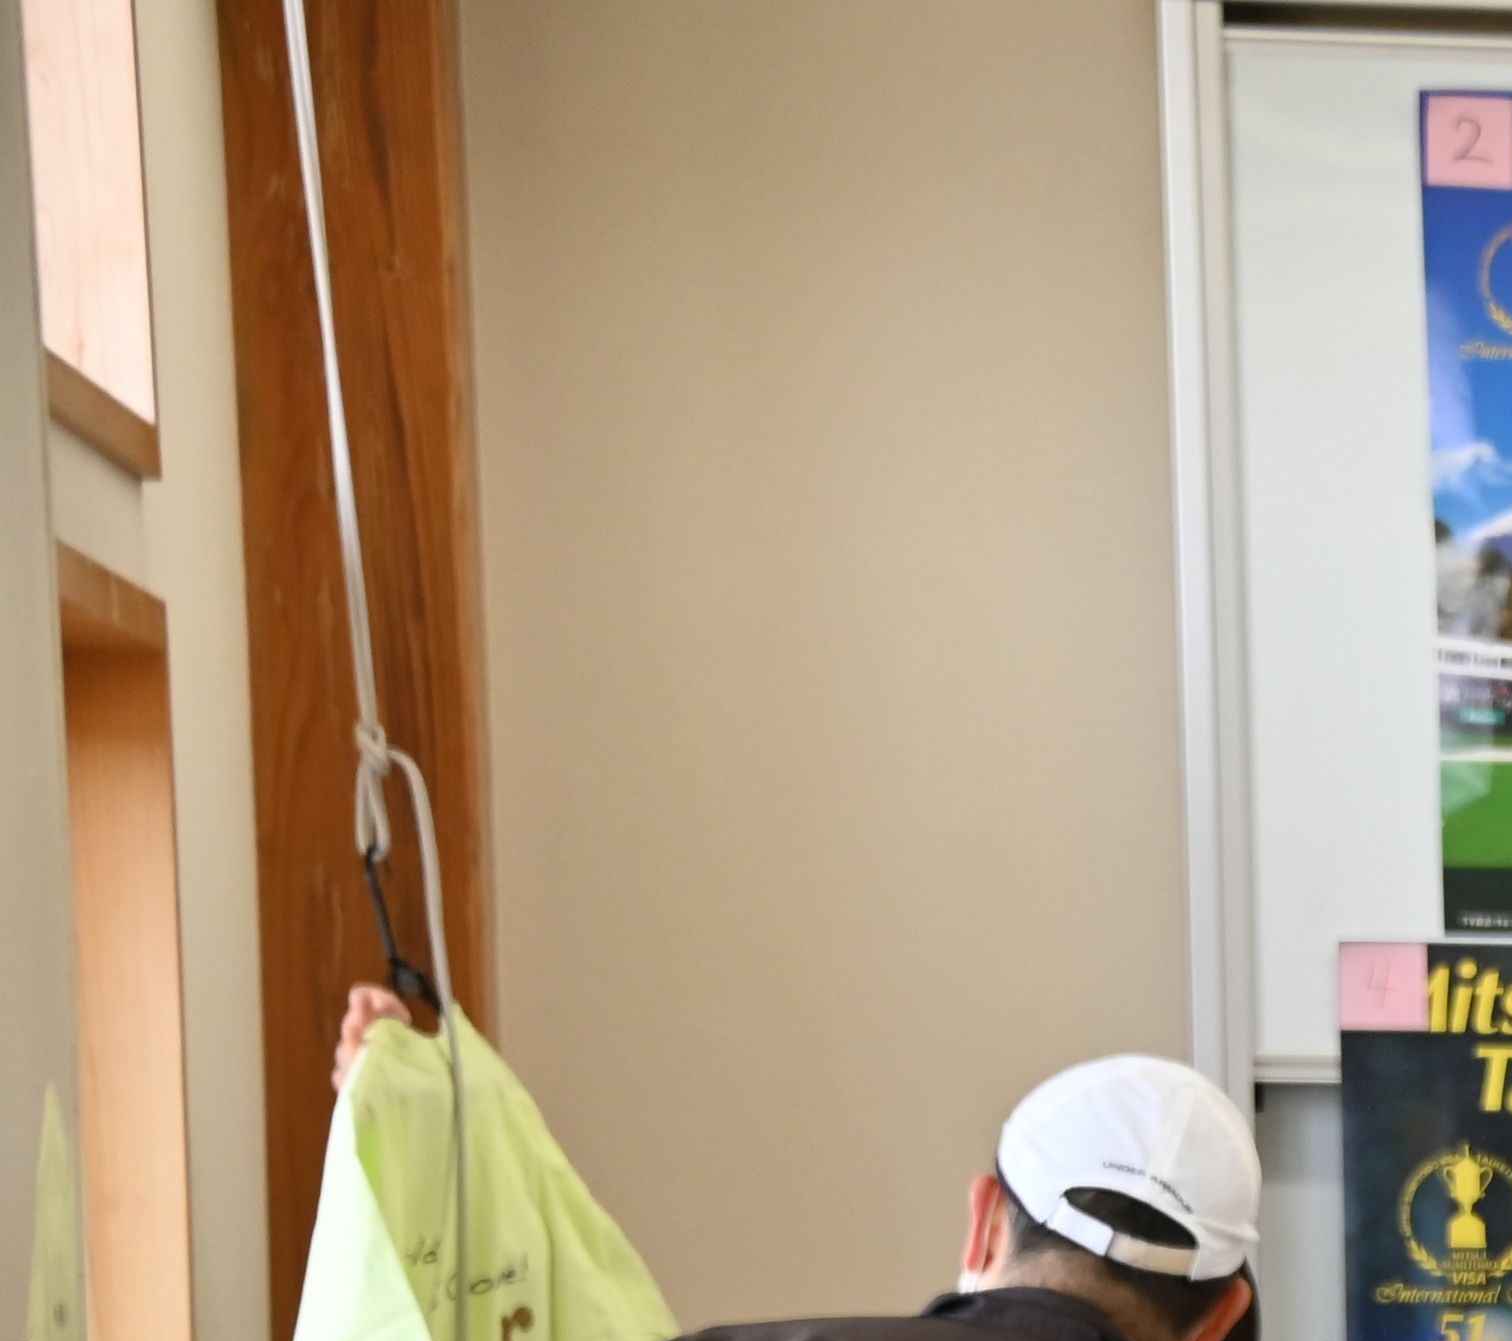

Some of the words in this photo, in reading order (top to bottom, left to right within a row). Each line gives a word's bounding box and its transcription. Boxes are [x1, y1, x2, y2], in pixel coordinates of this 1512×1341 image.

[1454, 114, 1495, 163] 2
[1452, 1271, 1487, 1285] VISA
[1375, 1282, 1501, 1305] International
